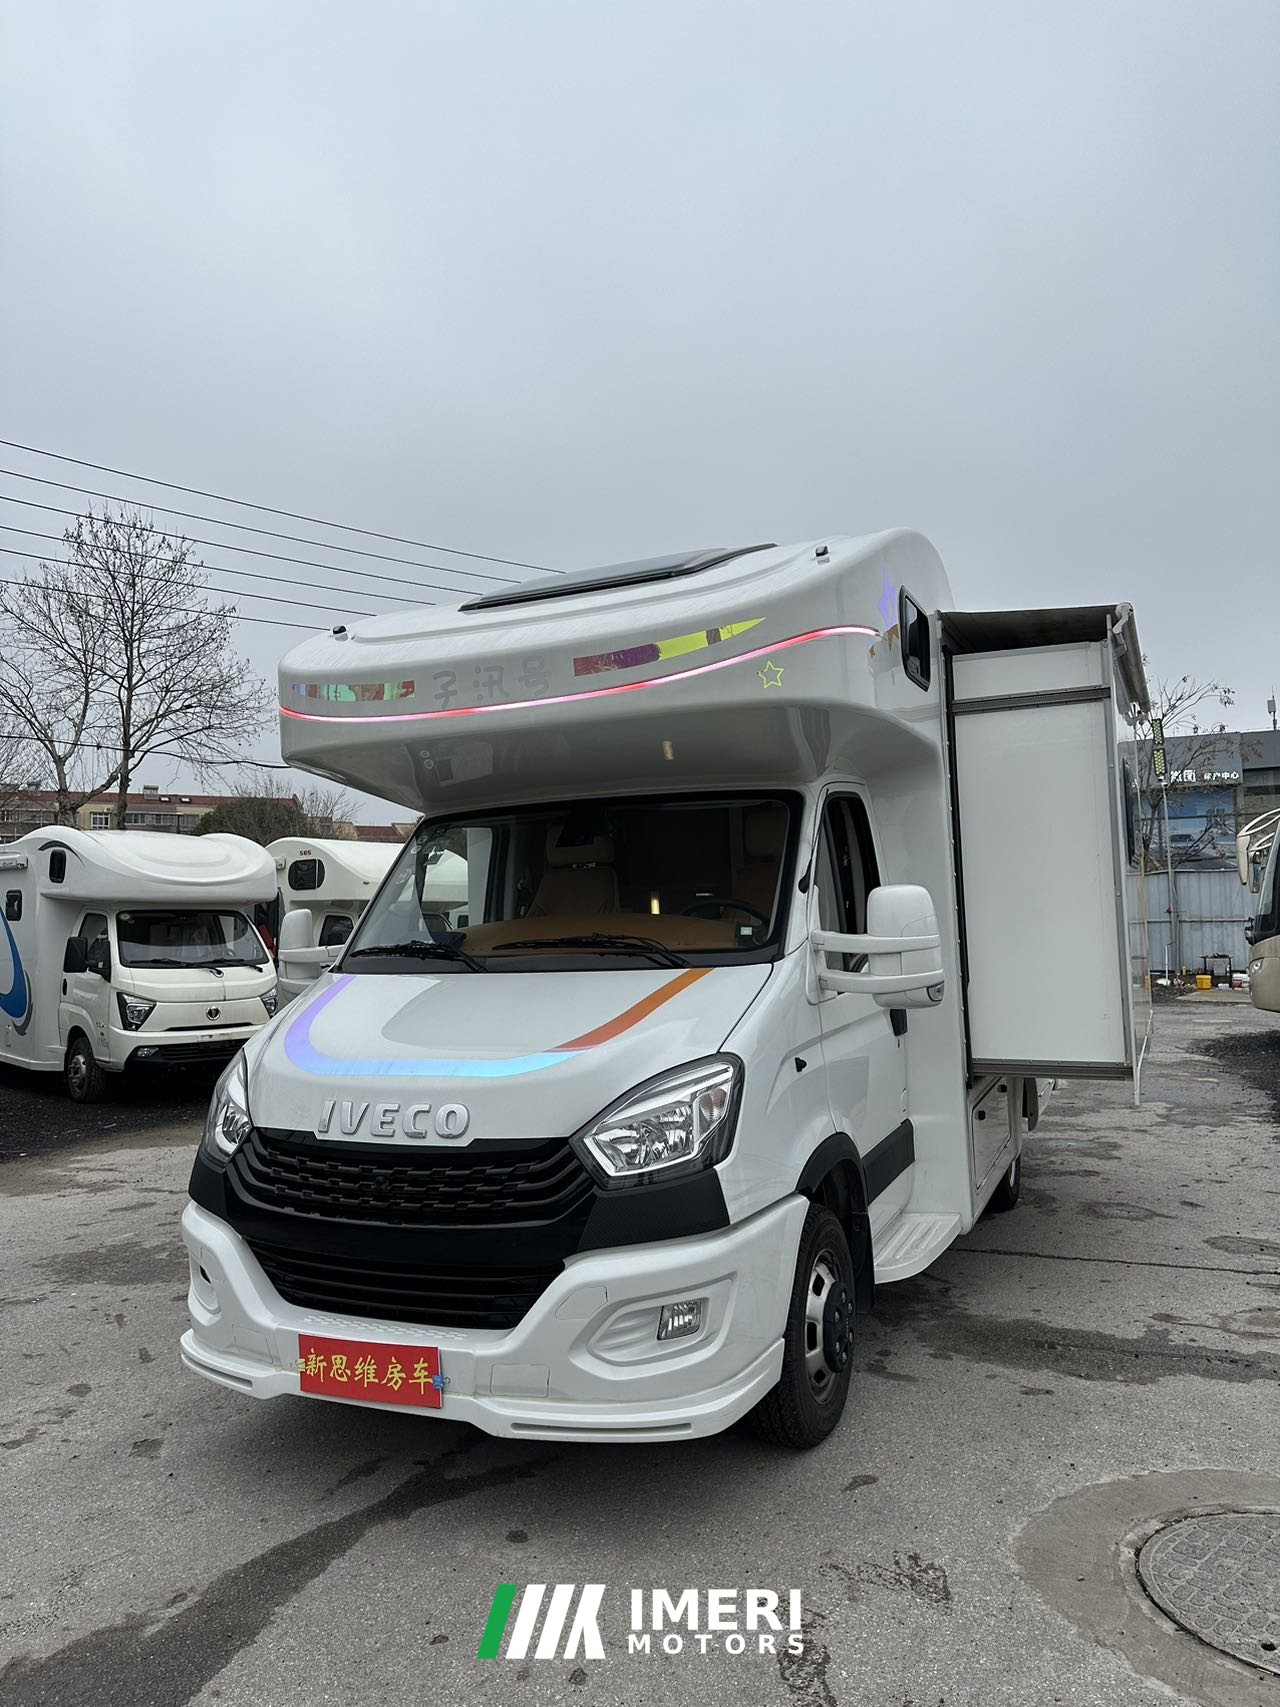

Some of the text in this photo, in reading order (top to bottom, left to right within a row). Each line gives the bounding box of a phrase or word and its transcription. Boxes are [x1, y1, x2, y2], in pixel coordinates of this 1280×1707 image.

[318, 1100, 470, 1139] IVECO
[305, 1347, 434, 1395] 新思维房车
